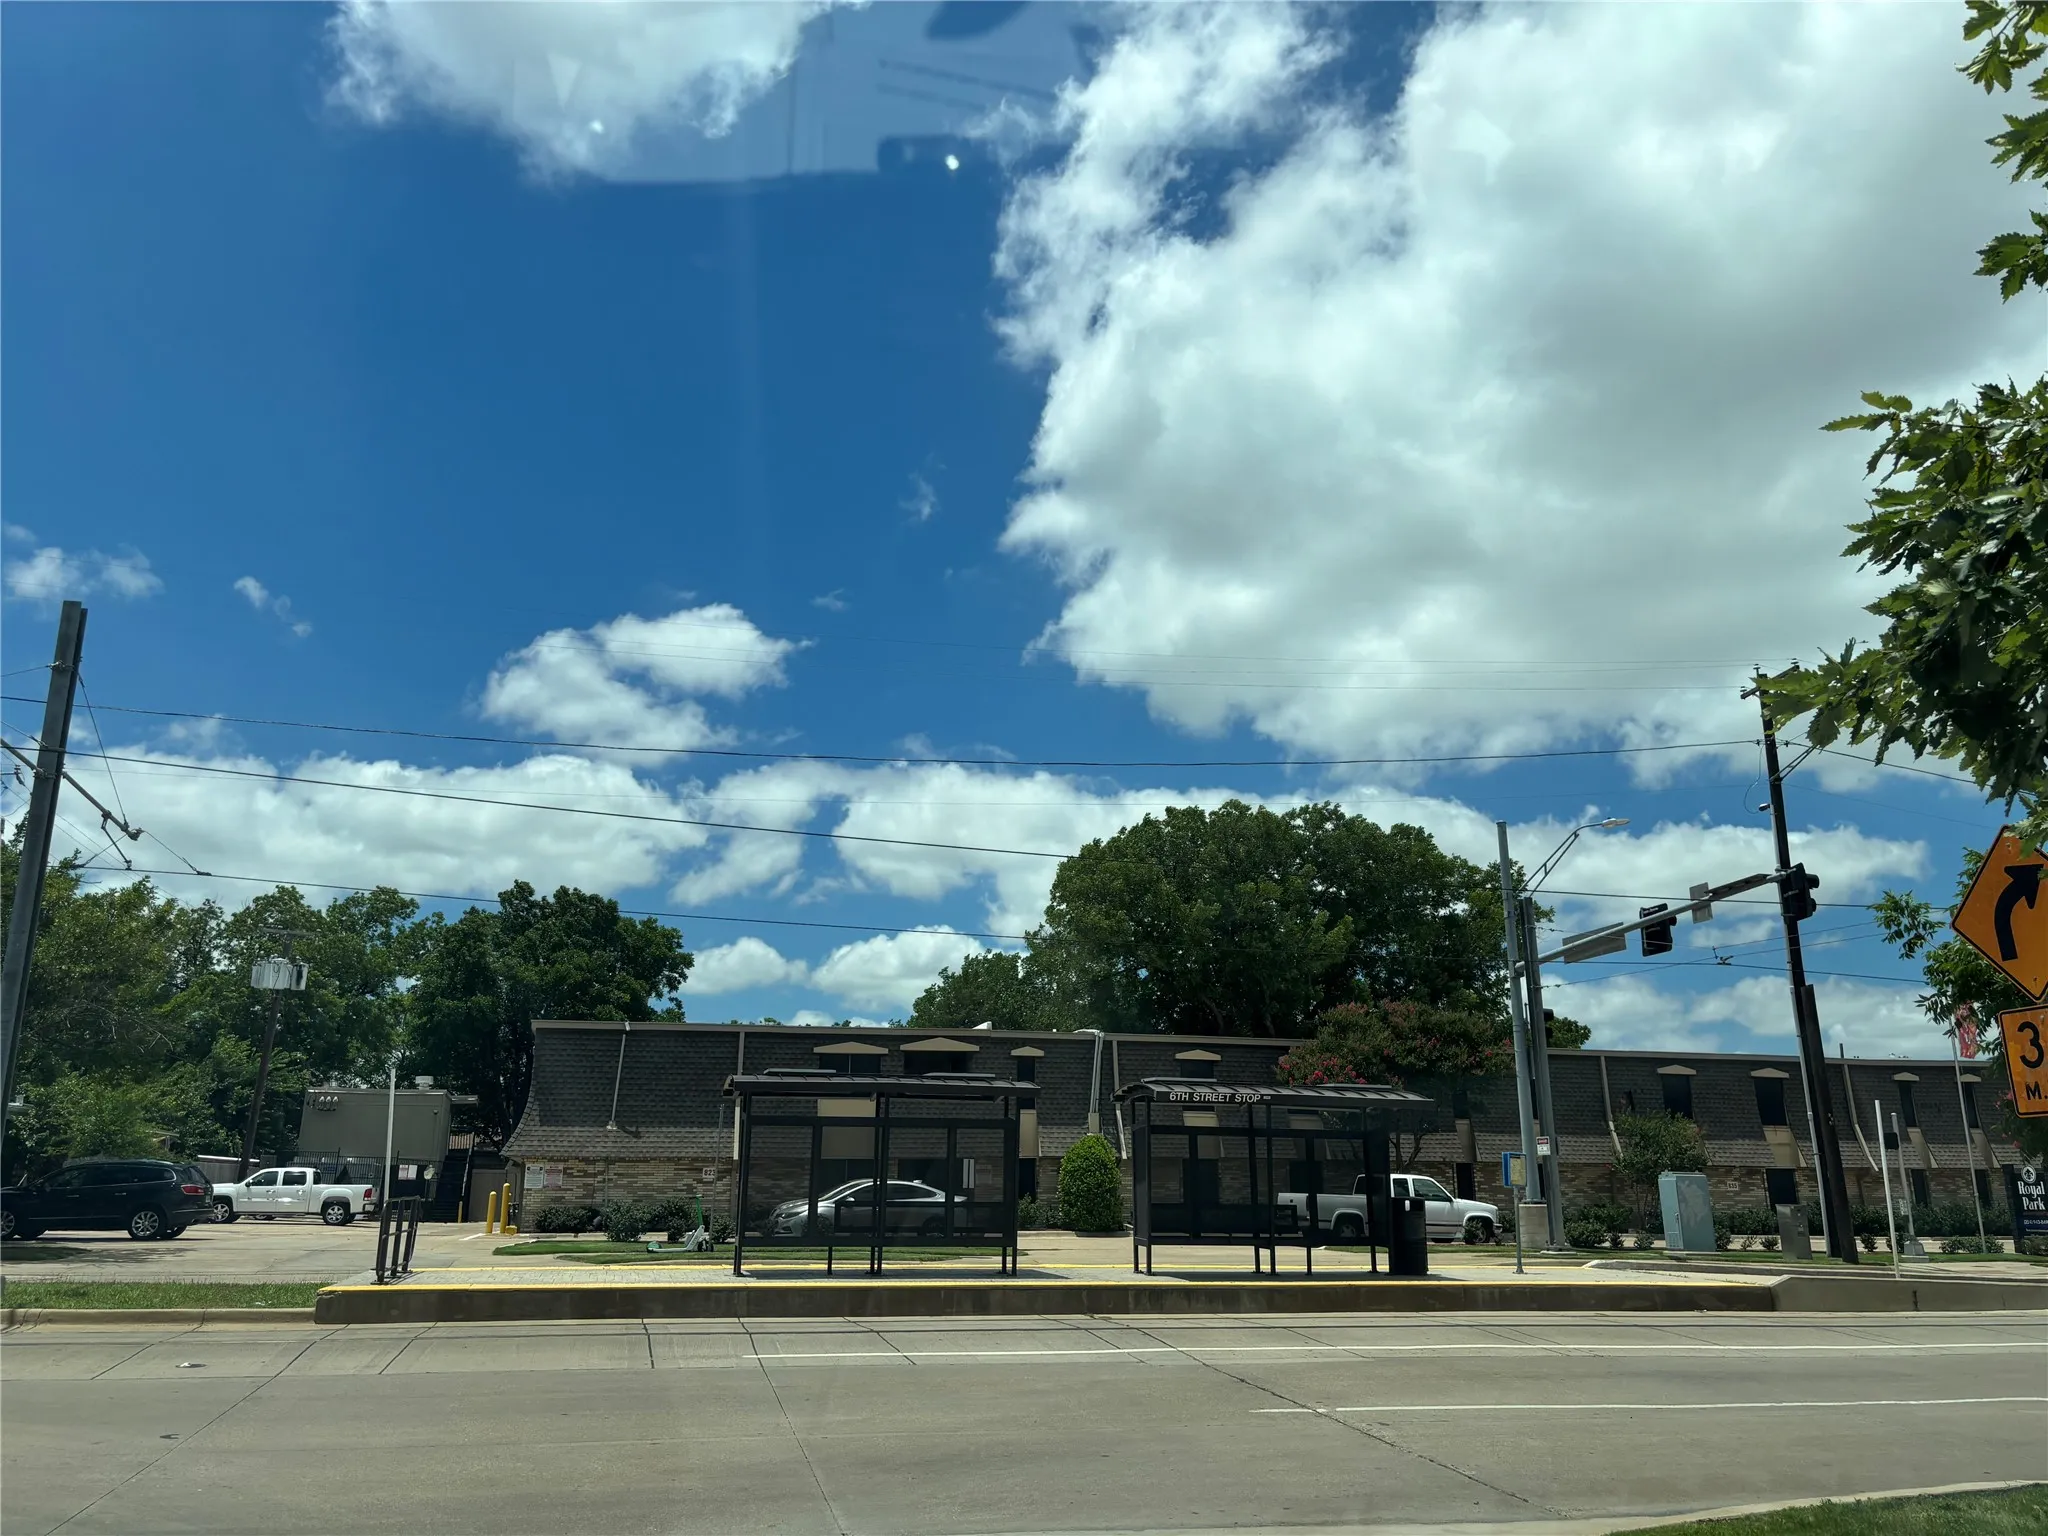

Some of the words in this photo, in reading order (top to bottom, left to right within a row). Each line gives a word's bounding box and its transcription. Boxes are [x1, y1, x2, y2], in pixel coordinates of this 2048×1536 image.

[1169, 1091, 1189, 1101] 6TH
[1193, 1092, 1232, 1102] STREET
[1235, 1093, 1261, 1103] STOP
[2017, 1181, 2046, 1199] Royal
[2022, 1196, 2046, 1211] Park
